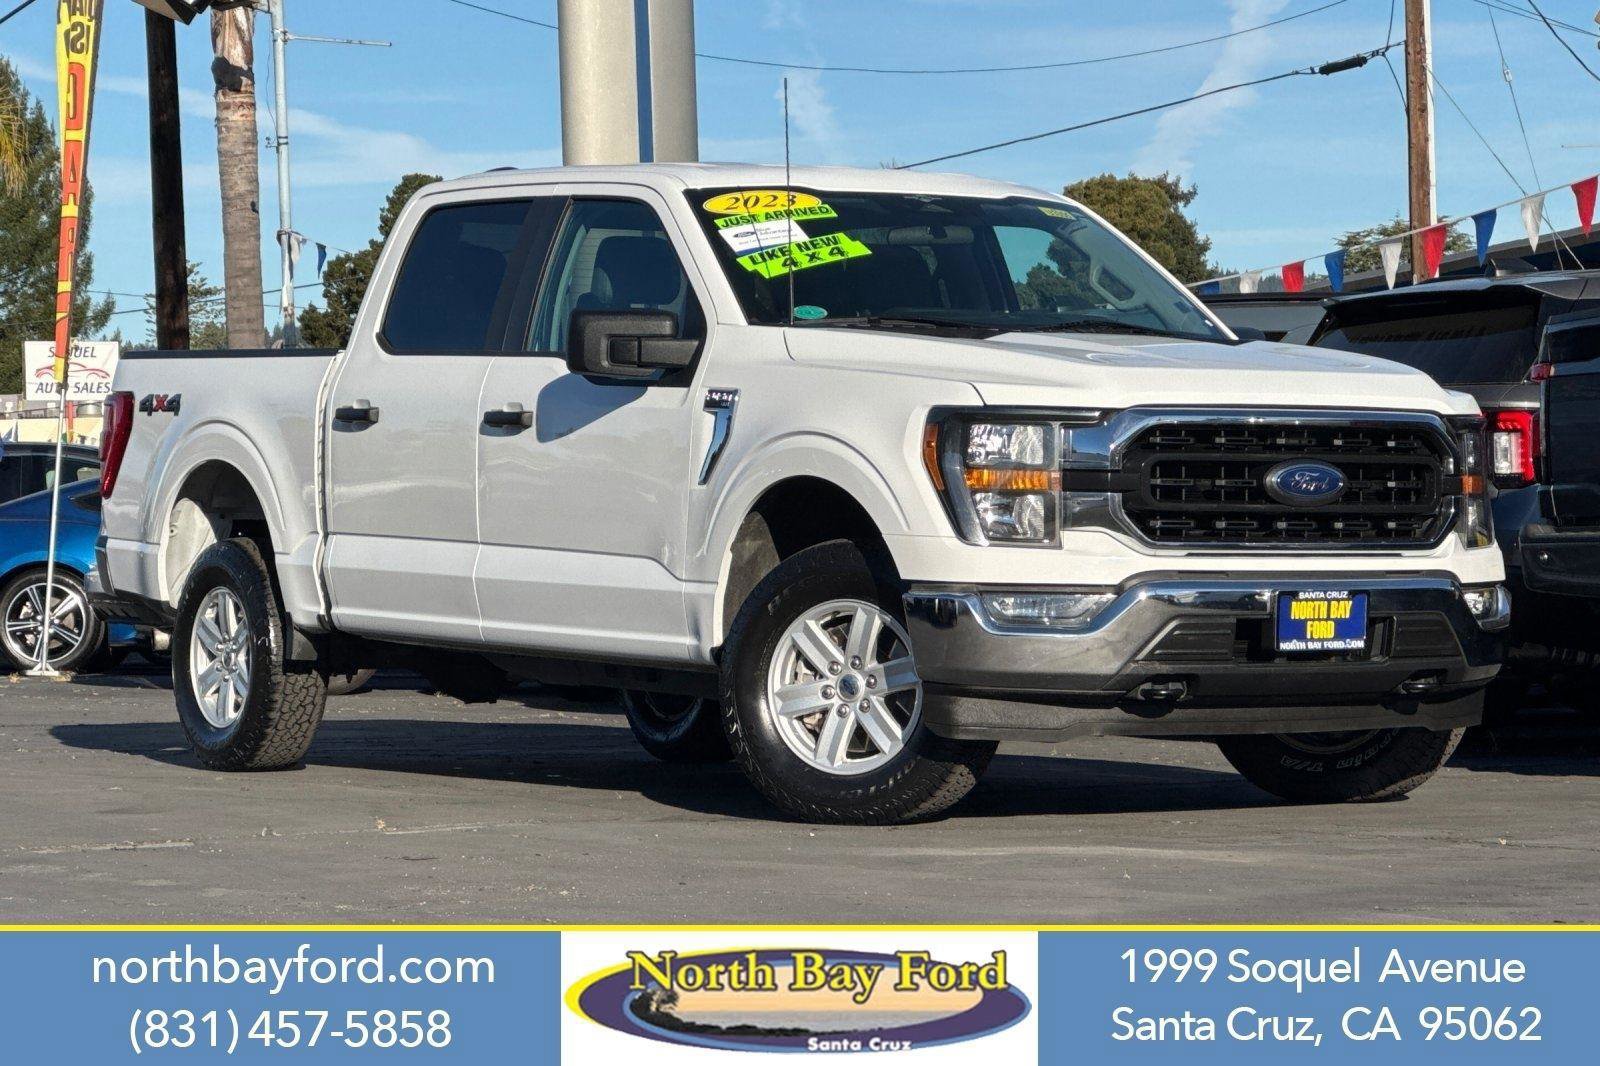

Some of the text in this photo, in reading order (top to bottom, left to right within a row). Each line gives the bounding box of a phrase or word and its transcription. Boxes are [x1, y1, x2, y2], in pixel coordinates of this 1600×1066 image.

[724, 193, 797, 210] 2023
[721, 205, 833, 229] JUST ARRIVED
[748, 245, 790, 265] LIKE
[795, 235, 841, 252] NEW
[48, 346, 97, 358] SUEL
[73, 382, 111, 393] SALES
[1291, 471, 1333, 493] Ford
[1298, 591, 1349, 599] SANTA CRUZ
[1290, 600, 1353, 620] NORTH BAY
[1306, 620, 1335, 640] FORD
[1280, 641, 1306, 650] NORTH
